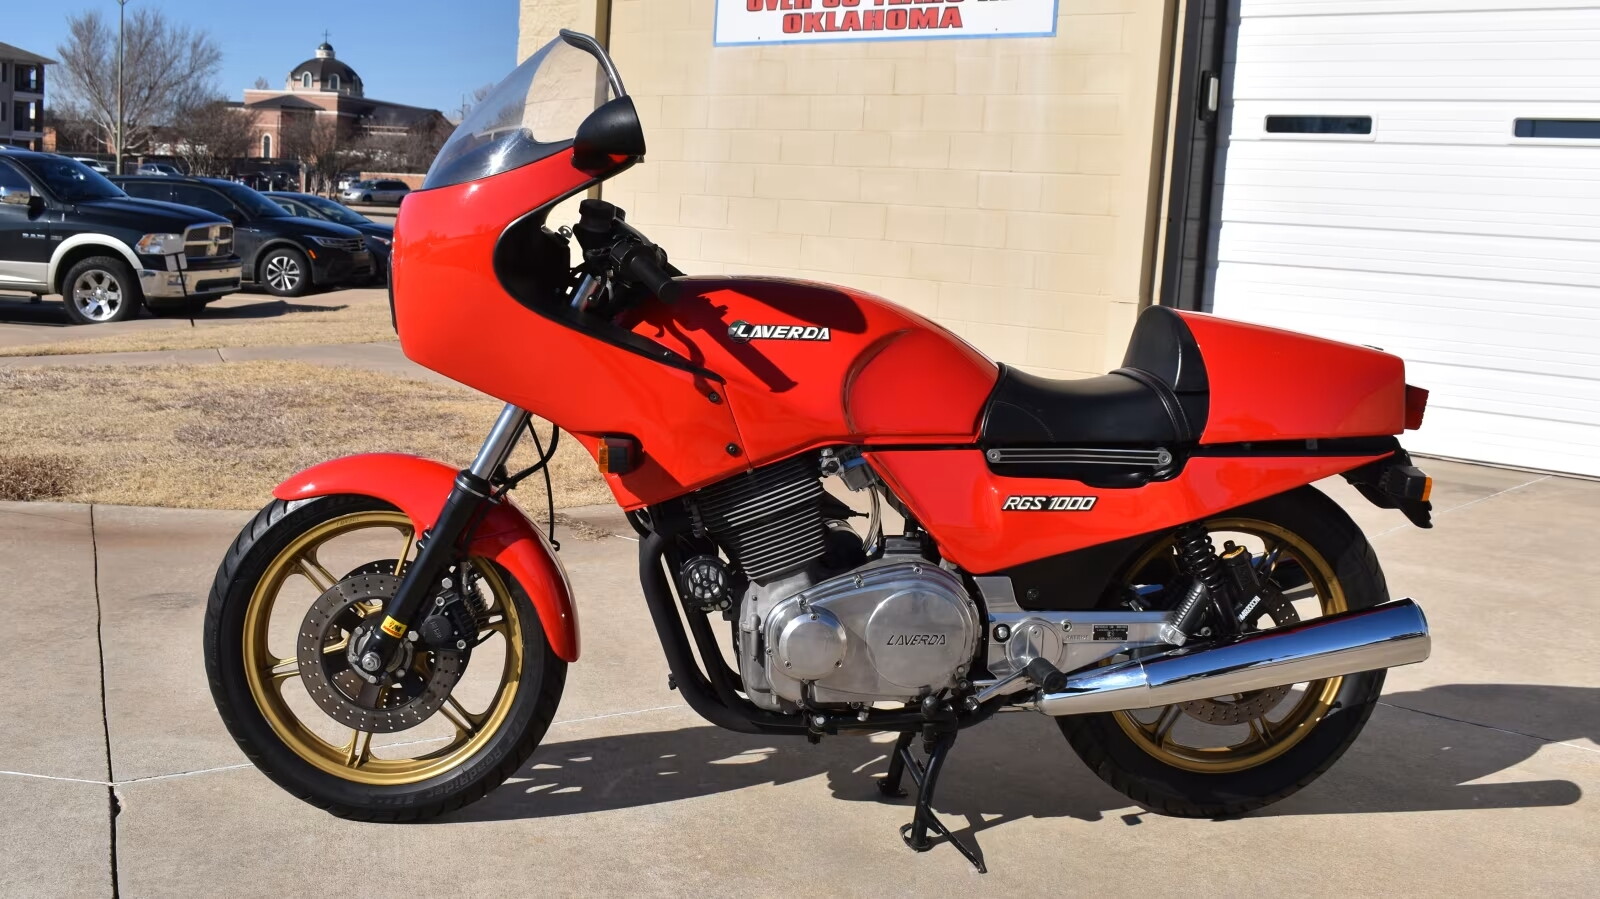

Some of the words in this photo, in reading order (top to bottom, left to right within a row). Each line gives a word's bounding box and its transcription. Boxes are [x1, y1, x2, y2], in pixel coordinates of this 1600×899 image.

[782, 6, 963, 33] OKLAHOMA
[735, 325, 830, 339] LAVERDA
[1002, 496, 1047, 510] RGS
[1048, 496, 1097, 510] 1000
[887, 634, 946, 646] LAVERDA
